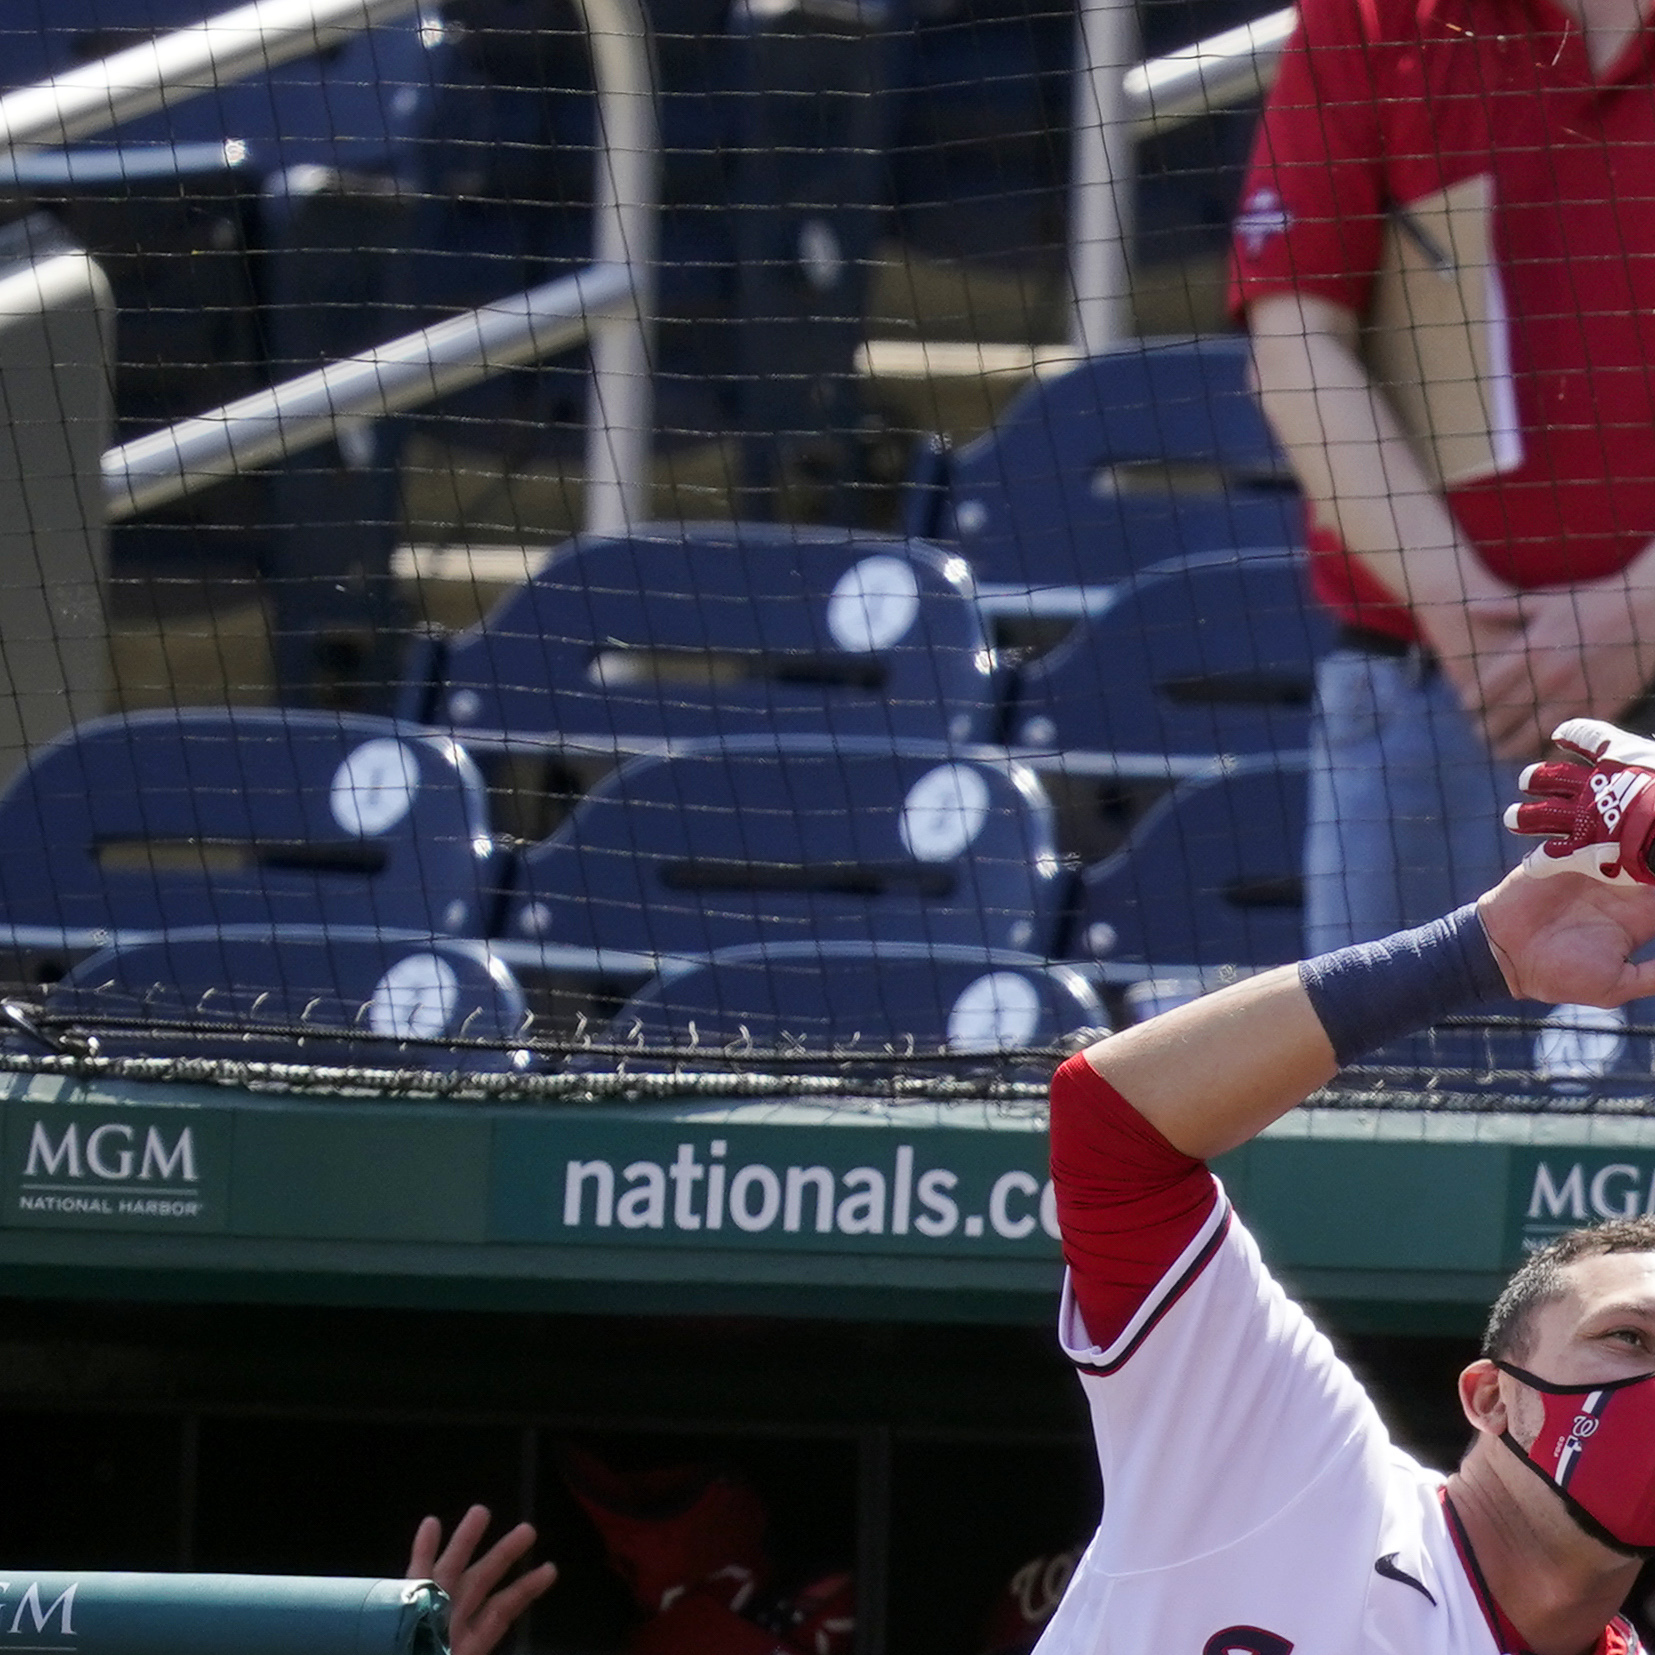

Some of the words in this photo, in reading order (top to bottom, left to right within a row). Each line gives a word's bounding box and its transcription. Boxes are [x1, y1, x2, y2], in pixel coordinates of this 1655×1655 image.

[23, 1120, 198, 1181] MGM
[19, 1196, 113, 1215] NATIONAL
[118, 1200, 199, 1217] HARBOR
[1573, 1415, 1600, 1438] W
[0, 1581, 79, 1635] M
